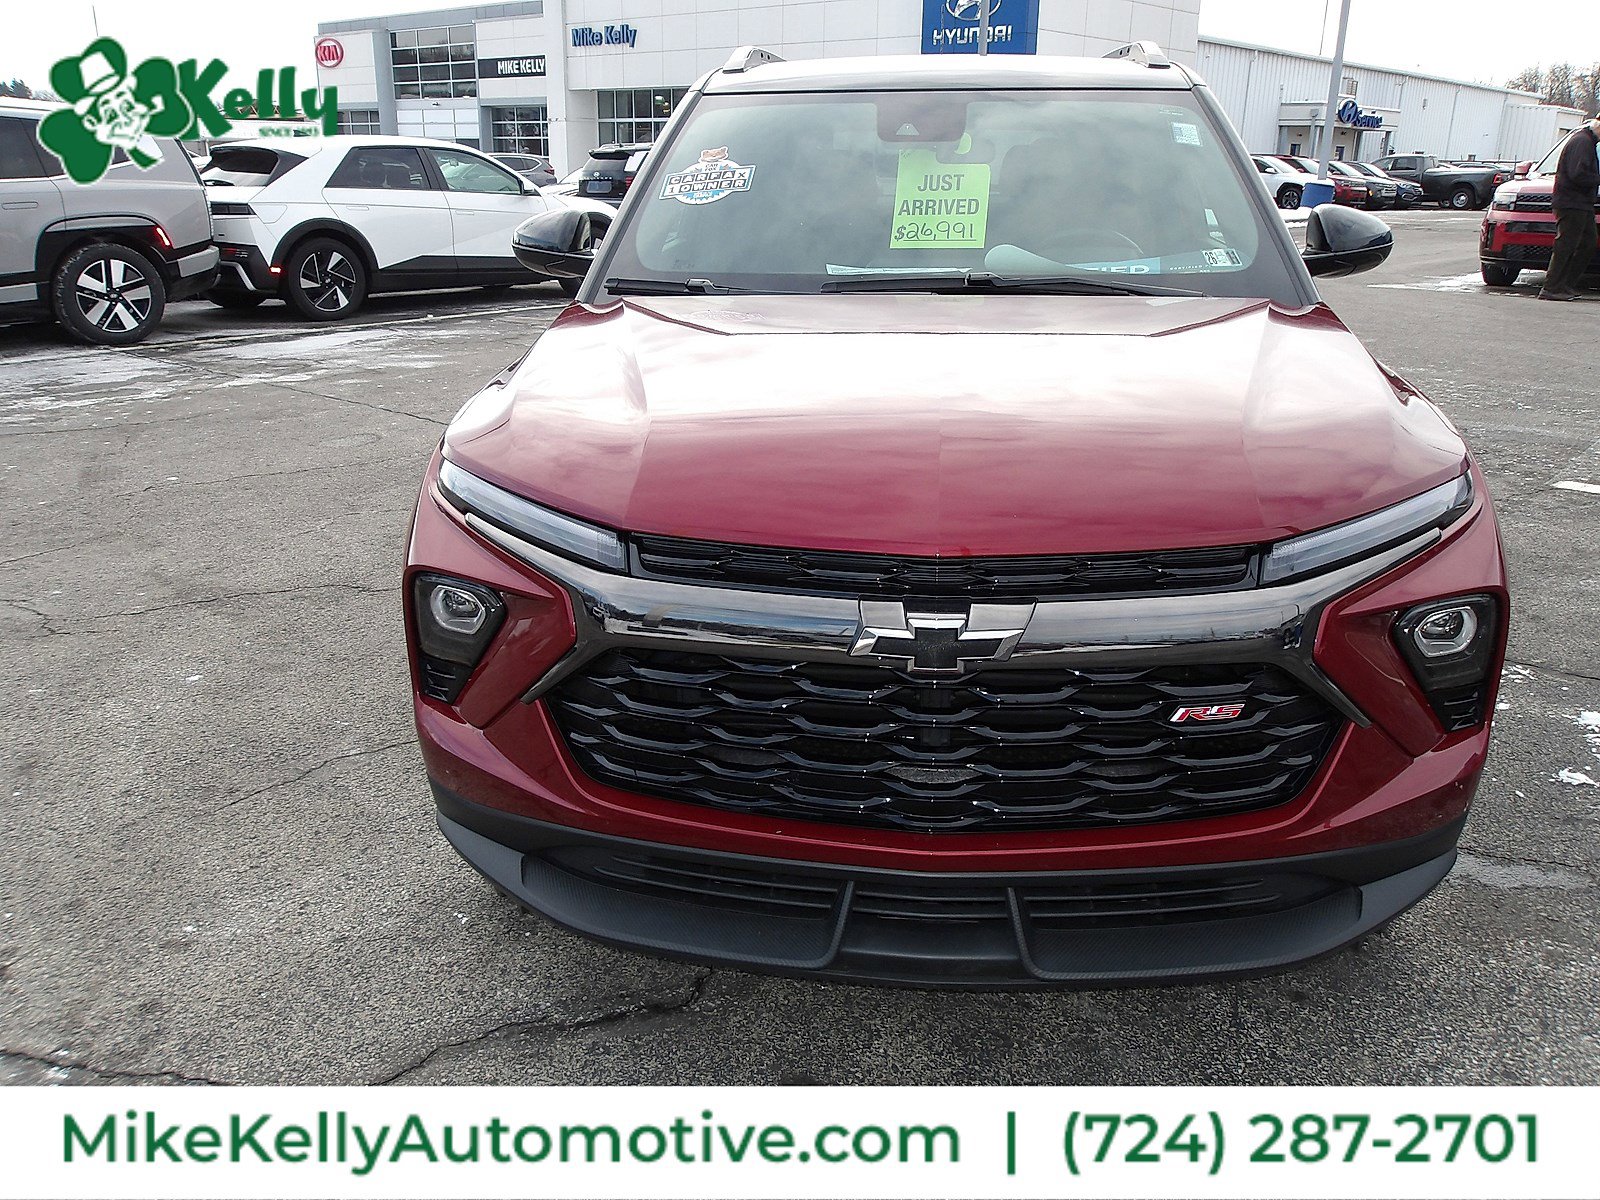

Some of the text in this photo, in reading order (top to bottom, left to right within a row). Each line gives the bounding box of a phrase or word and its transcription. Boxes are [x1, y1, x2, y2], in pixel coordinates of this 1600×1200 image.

[571, 24, 637, 48] Mike Kelly
[318, 45, 339, 61] KIA
[497, 59, 545, 74] MIKE KELLY
[669, 171, 747, 184] CARFAX
[680, 179, 746, 193] OWNER
[917, 174, 965, 192] JUST
[897, 198, 980, 216] ARRIVED
[894, 221, 975, 241] $26,991
[1169, 703, 1246, 722] RS
